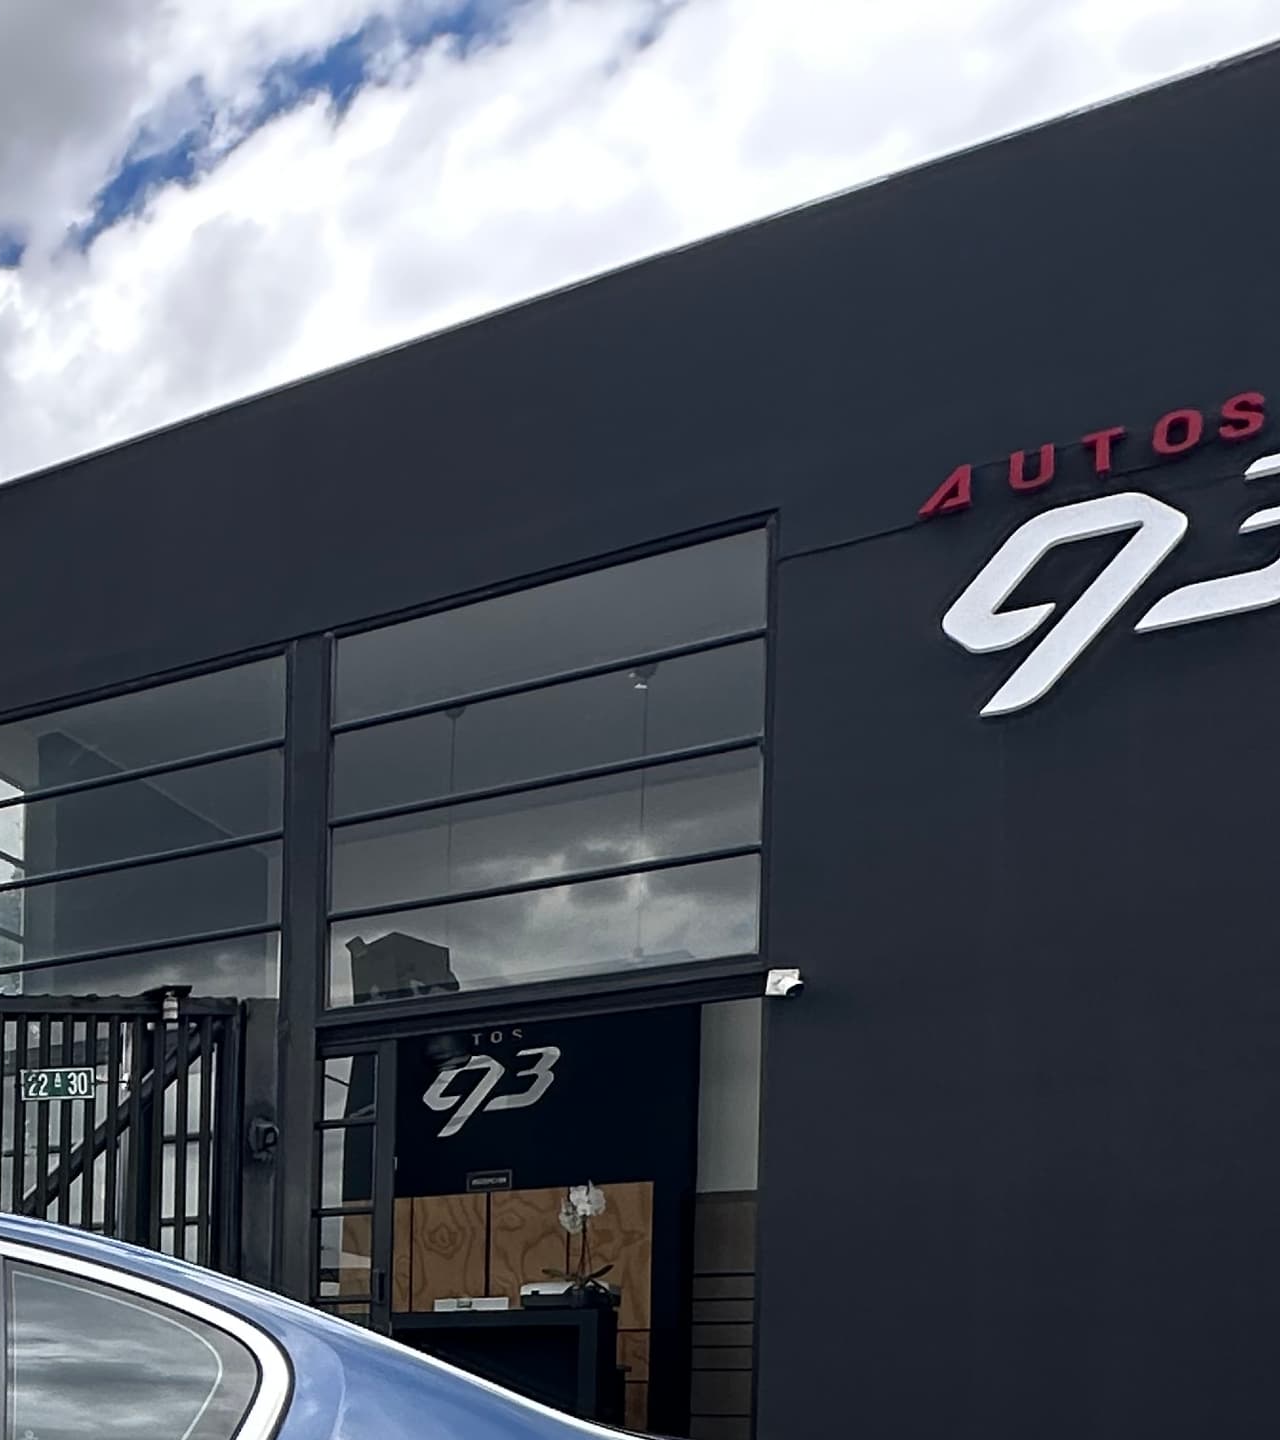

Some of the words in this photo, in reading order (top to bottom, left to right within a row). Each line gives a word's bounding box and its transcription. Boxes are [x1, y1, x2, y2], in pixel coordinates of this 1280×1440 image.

[918, 392, 1266, 520] AUTOS
[472, 1028, 523, 1046] TOS
[67, 1072, 88, 1095] 30
[423, 1046, 561, 1138] 93
